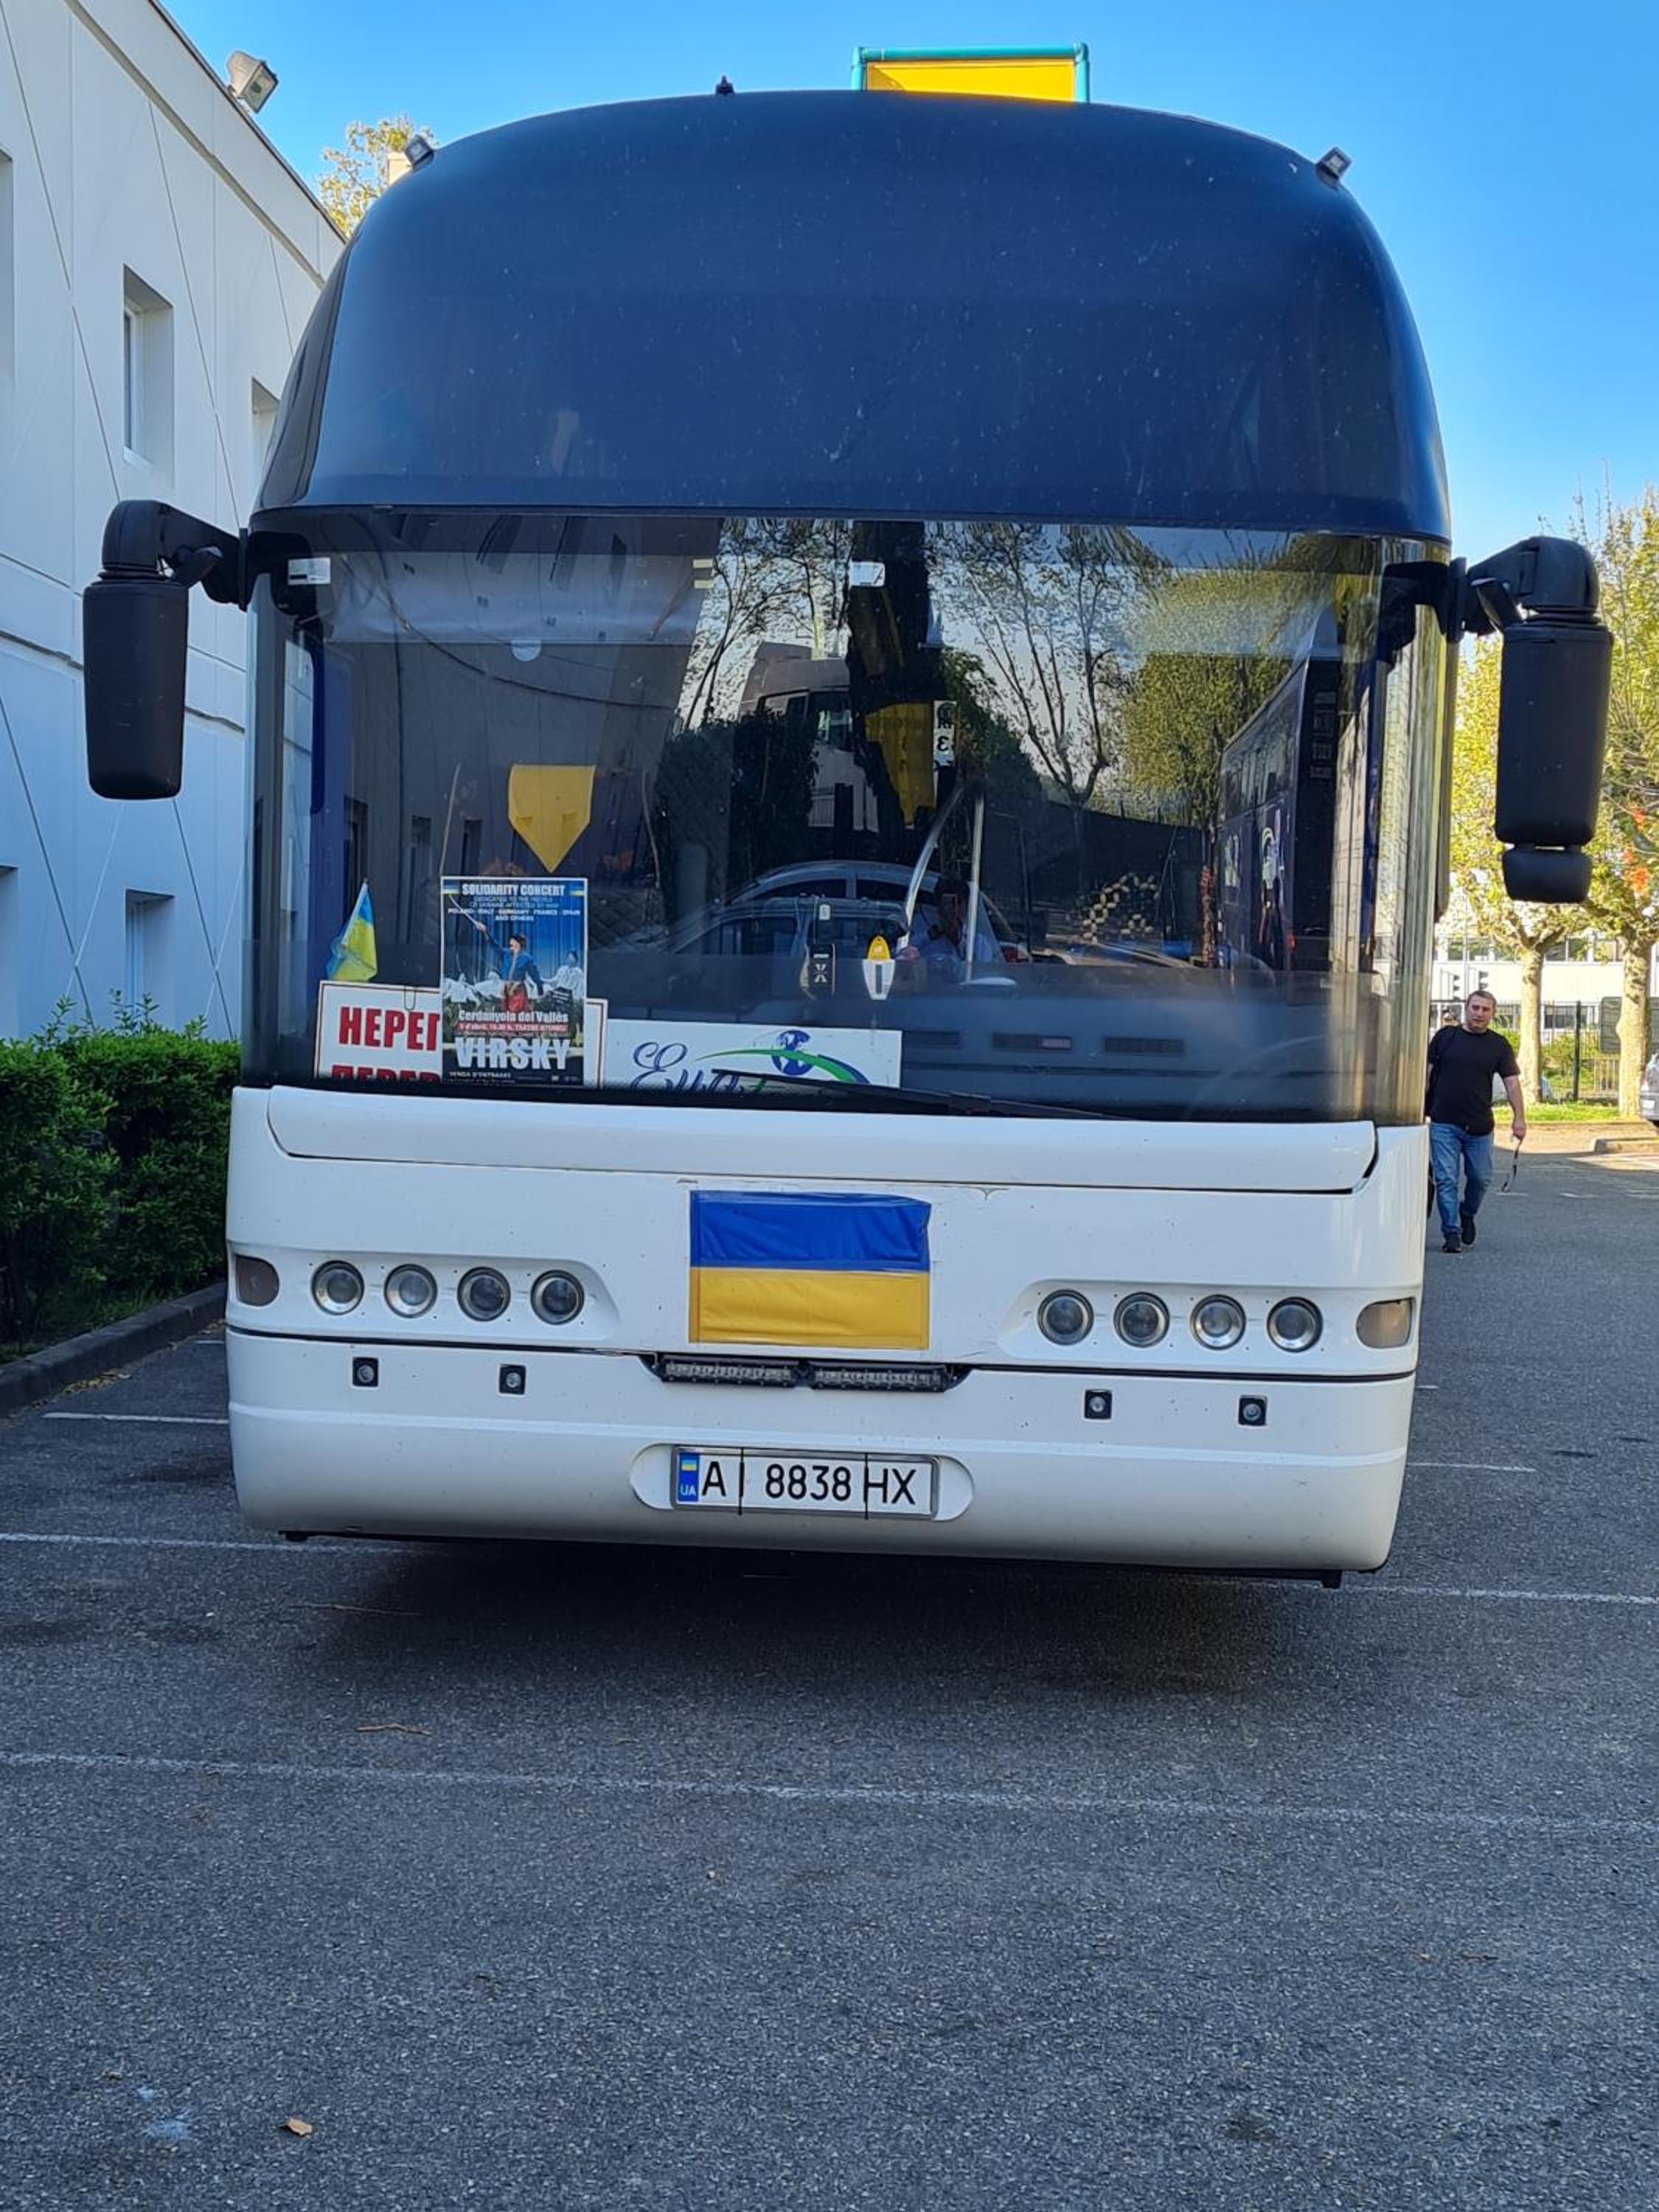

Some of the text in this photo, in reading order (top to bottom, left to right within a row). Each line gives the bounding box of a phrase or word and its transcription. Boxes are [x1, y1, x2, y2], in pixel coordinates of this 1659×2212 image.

[462, 883, 566, 897] SOLIDARITY CONCERT
[459, 1009, 516, 1023] Cerdanyola
[518, 1011, 535, 1022] del
[454, 1036, 571, 1070] VIRSKY
[680, 1484, 696, 1496] UA
[765, 1463, 852, 1502] 8838
[863, 1467, 917, 1505] HX
